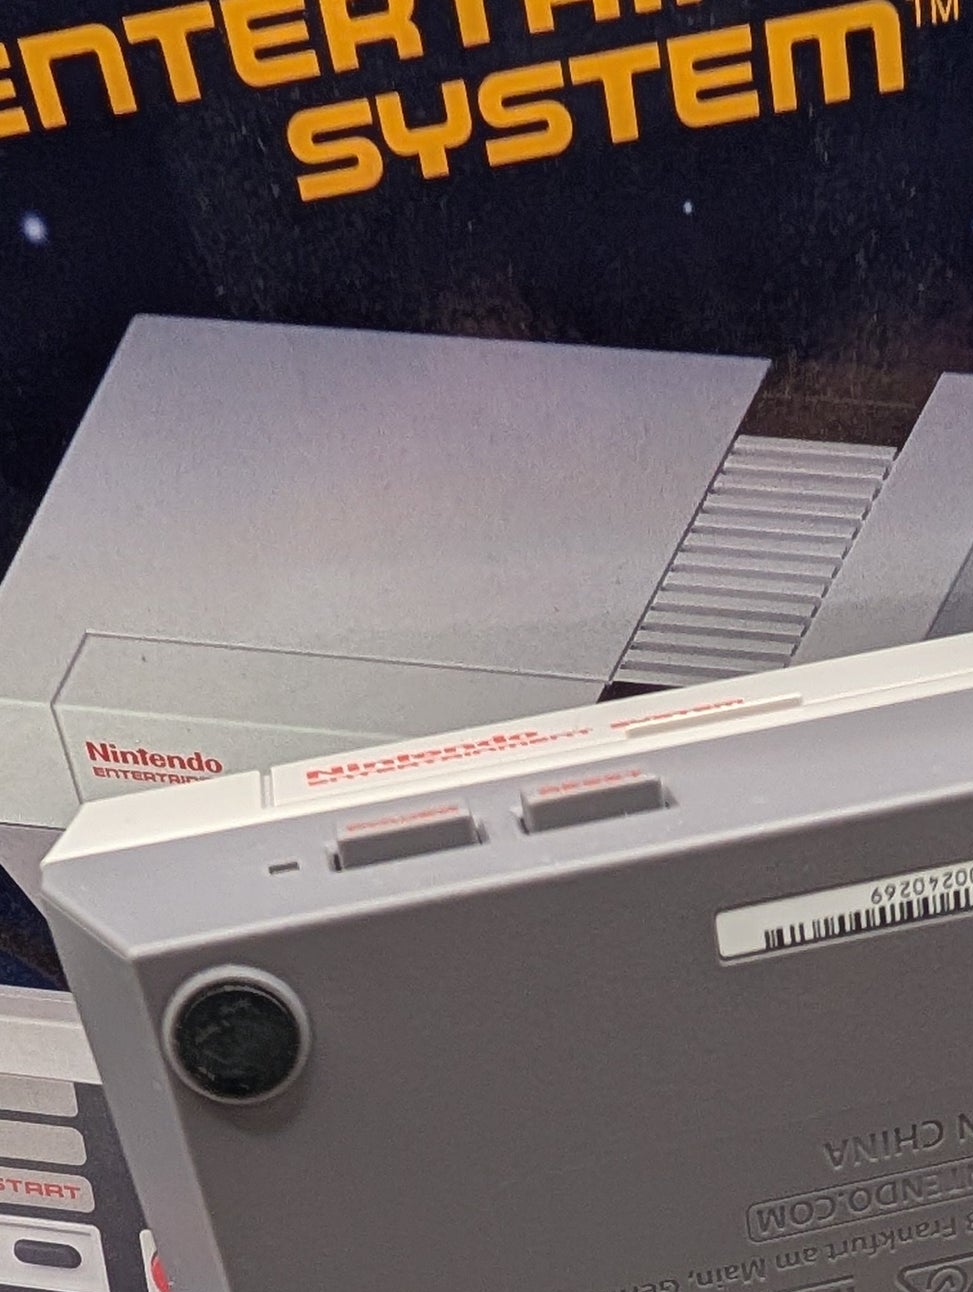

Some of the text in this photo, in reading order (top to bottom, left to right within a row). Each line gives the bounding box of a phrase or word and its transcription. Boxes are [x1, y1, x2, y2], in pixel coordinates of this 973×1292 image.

[86, 741, 223, 774] Nintendo
[823, 1116, 942, 1172] CHINA
[775, 1245, 816, 1270] am
[827, 1213, 956, 1264] Frankfurt
